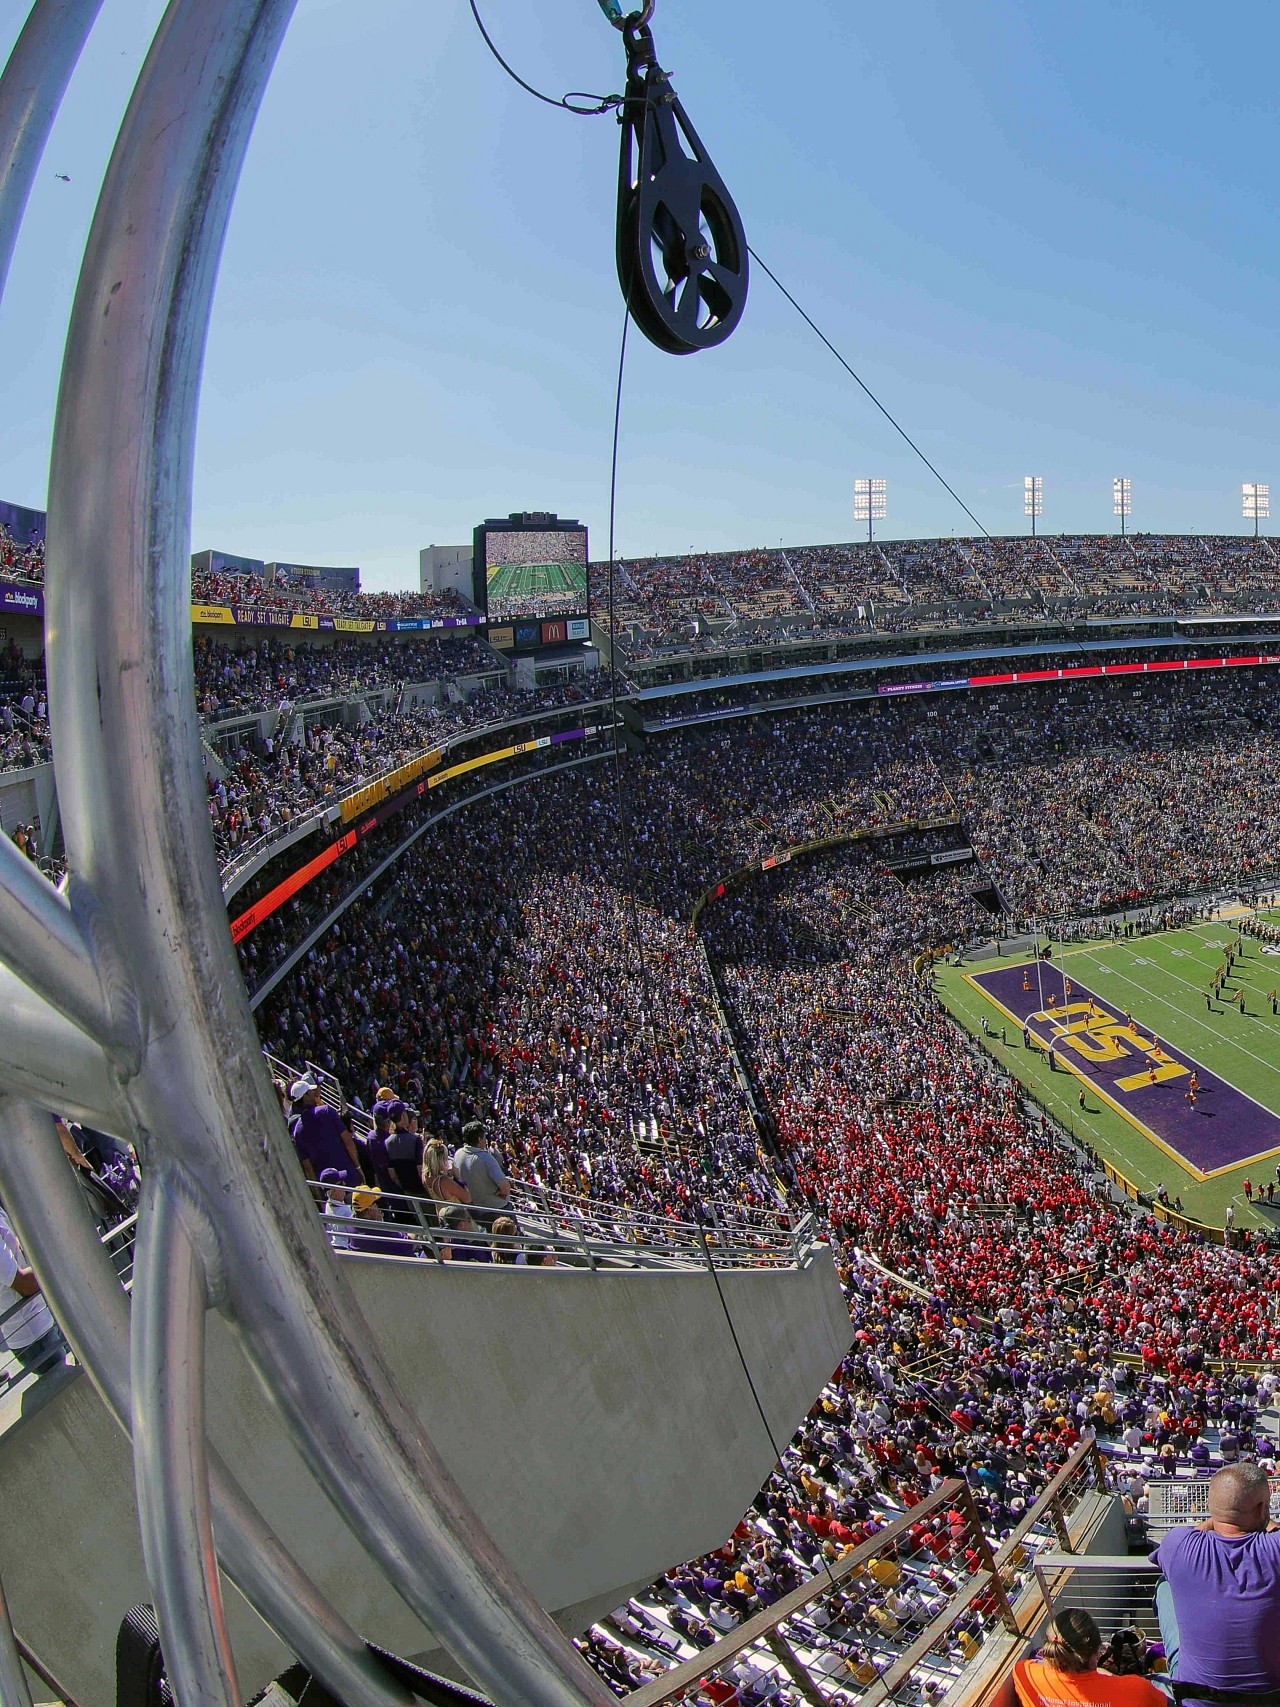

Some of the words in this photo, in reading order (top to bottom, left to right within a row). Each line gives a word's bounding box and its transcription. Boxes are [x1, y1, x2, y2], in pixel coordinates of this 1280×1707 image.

[522, 511, 550, 525] LSU
[269, 612, 290, 625] TAILGATE
[302, 616, 312, 627] LSU
[926, 710, 938, 718] 100
[512, 743, 526, 754] LSU
[965, 881, 989, 889] WWL
[1033, 1002, 1191, 1092] LSU
